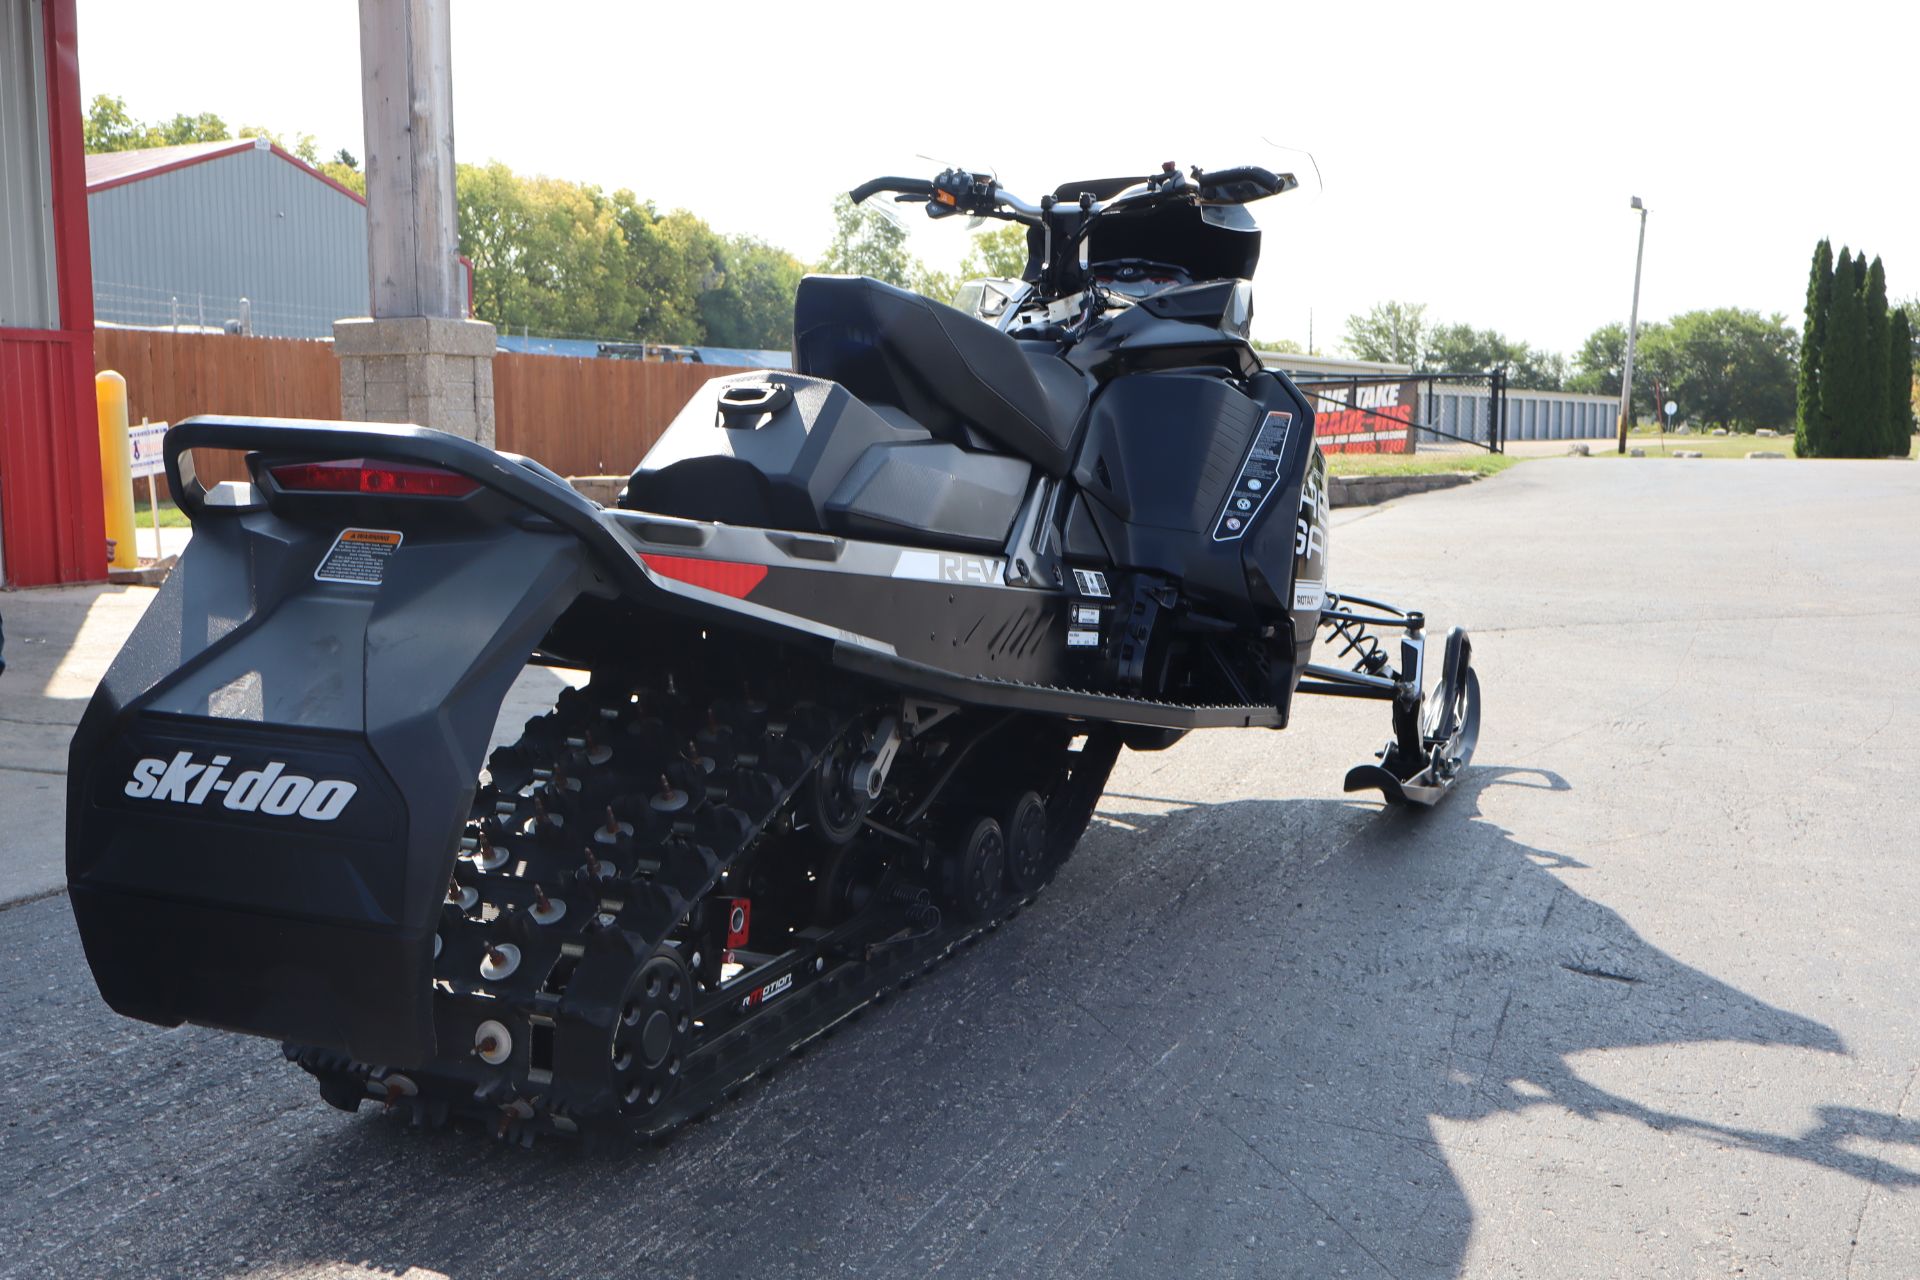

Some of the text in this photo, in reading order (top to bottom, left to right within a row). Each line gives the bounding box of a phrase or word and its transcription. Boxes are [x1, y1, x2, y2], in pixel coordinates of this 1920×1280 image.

[1316, 384, 1400, 413] WE TAKE
[1315, 404, 1411, 437] RADE-INS
[1375, 429, 1408, 441] WELCOME
[1344, 440, 1376, 454] BIKES
[938, 553, 1000, 584] REV
[1296, 594, 1314, 606] ROTAX
[124, 751, 358, 821] ski-doo
